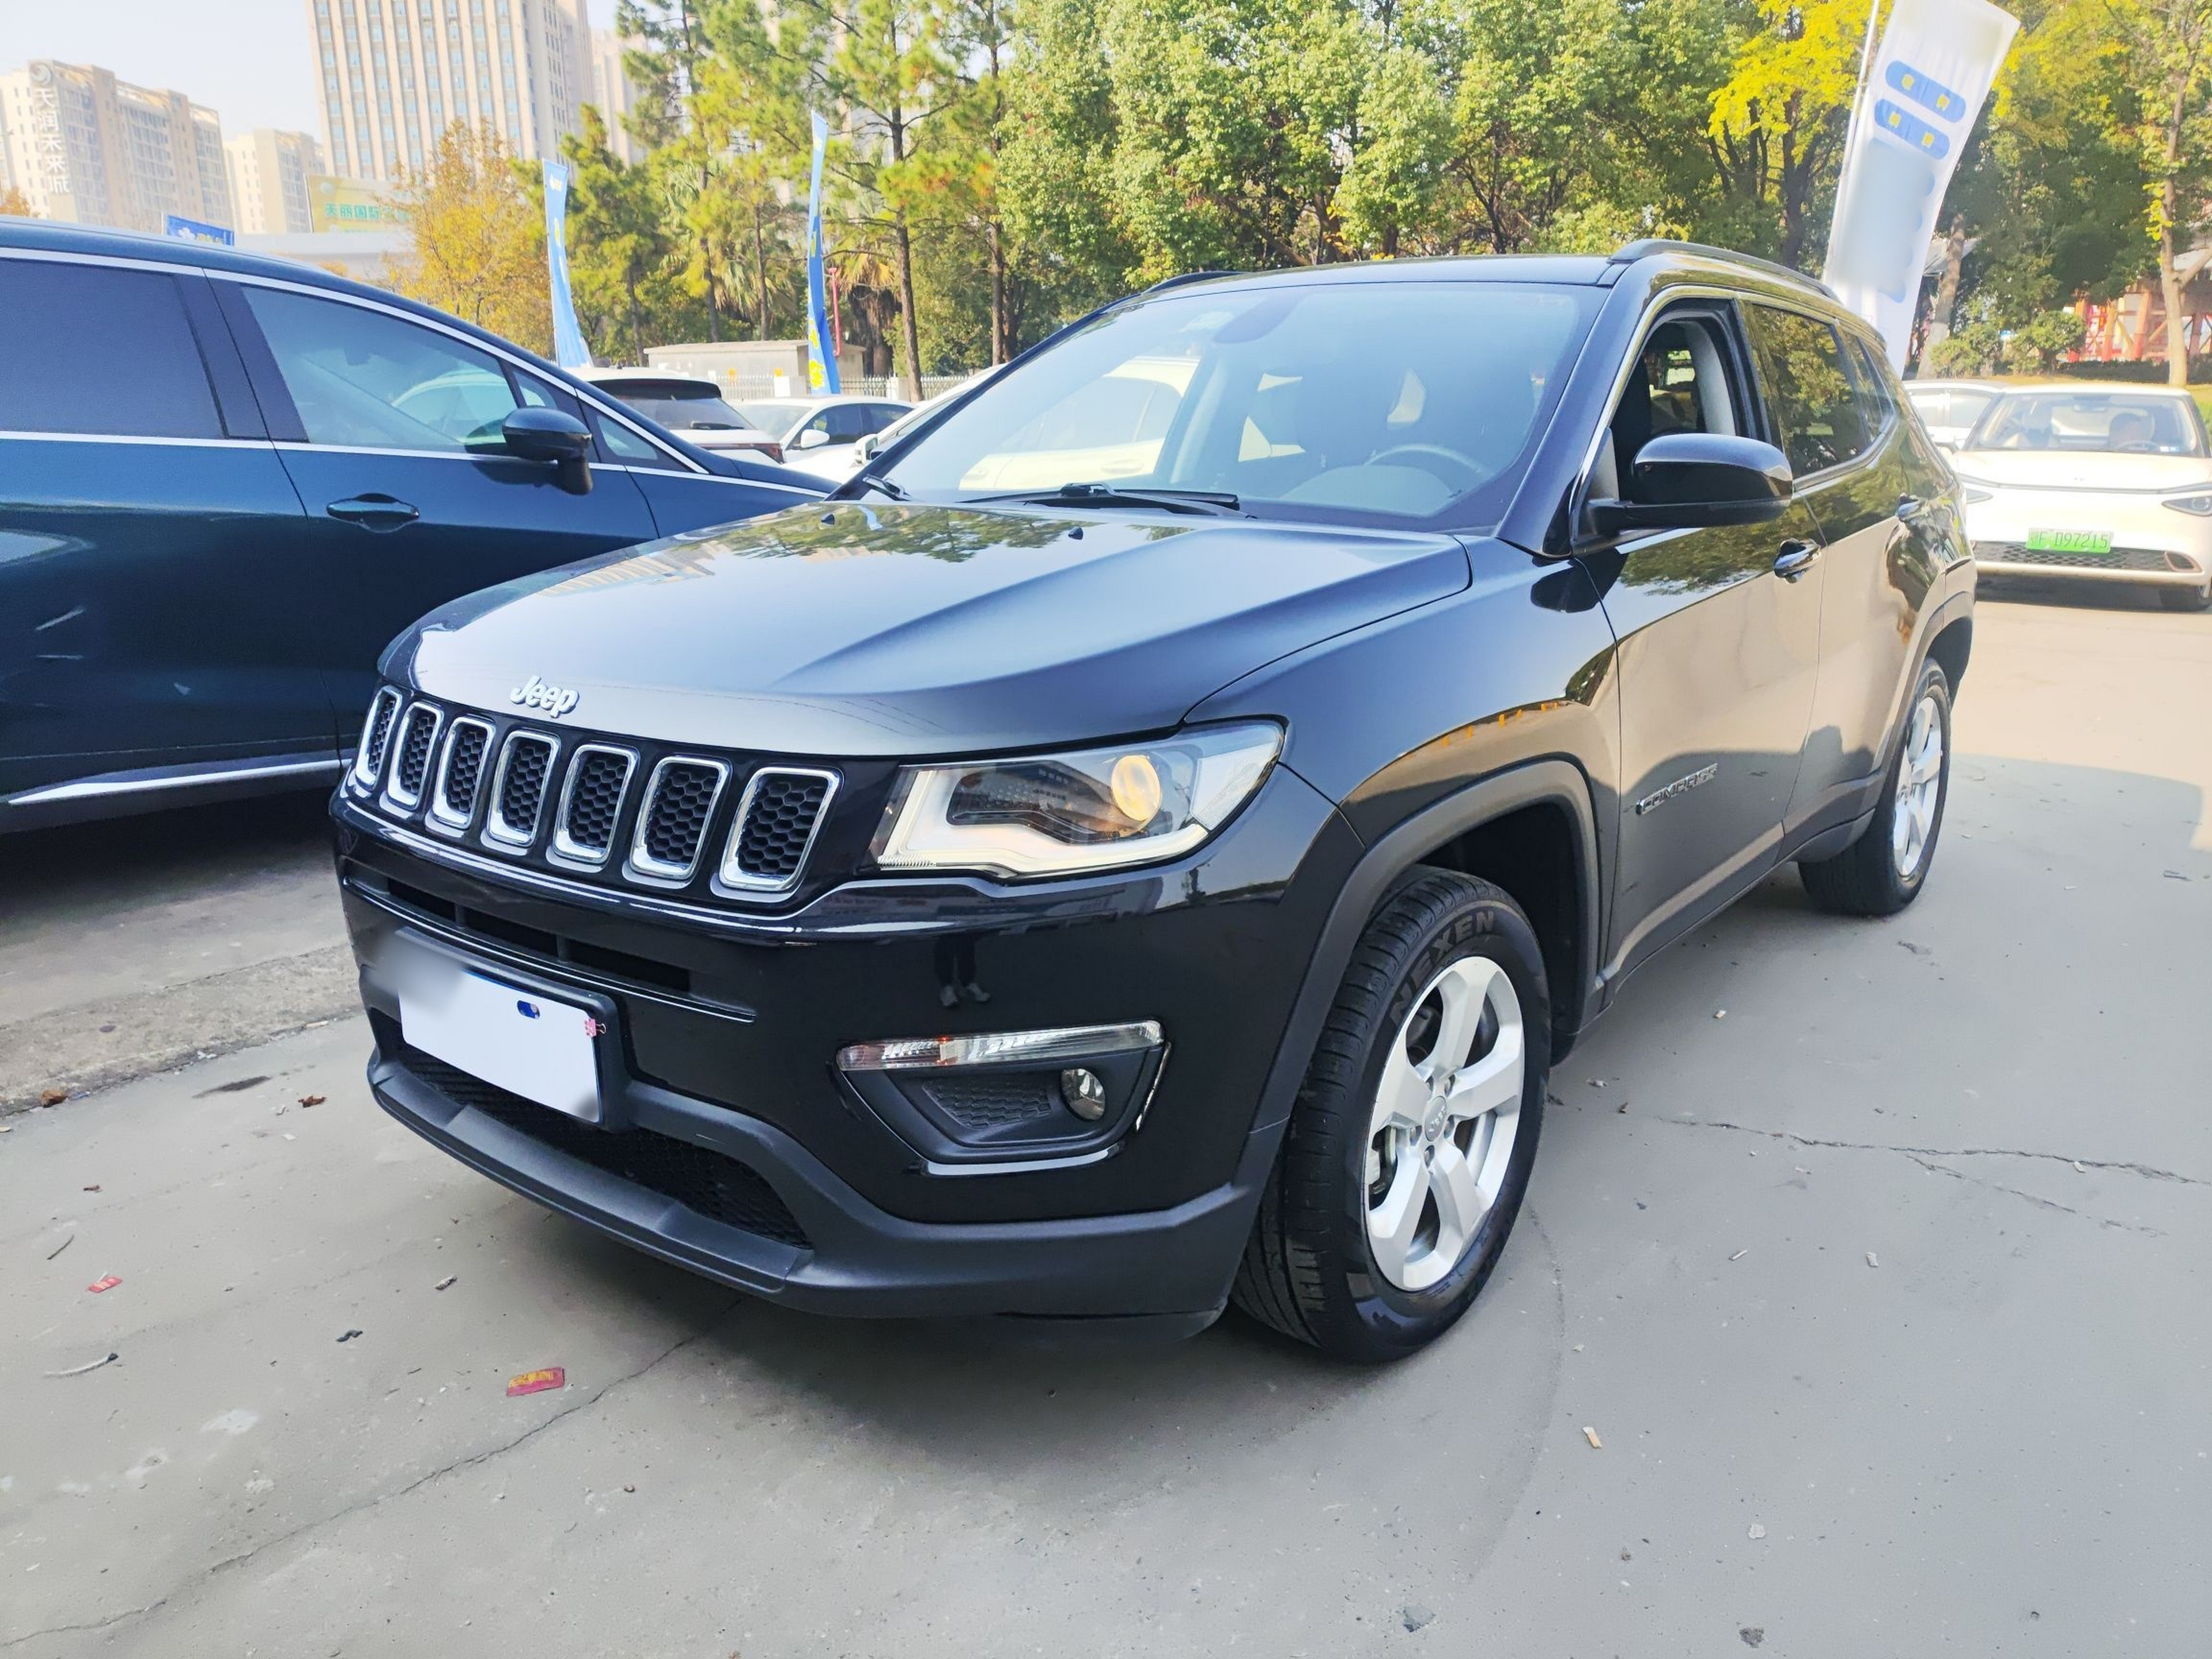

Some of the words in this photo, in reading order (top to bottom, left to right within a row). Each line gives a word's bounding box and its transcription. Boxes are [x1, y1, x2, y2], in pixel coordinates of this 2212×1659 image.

[510, 675, 580, 718] Jeep
[1636, 763, 1718, 815] COMPASS
[1389, 910, 1494, 1028] NEXEN
